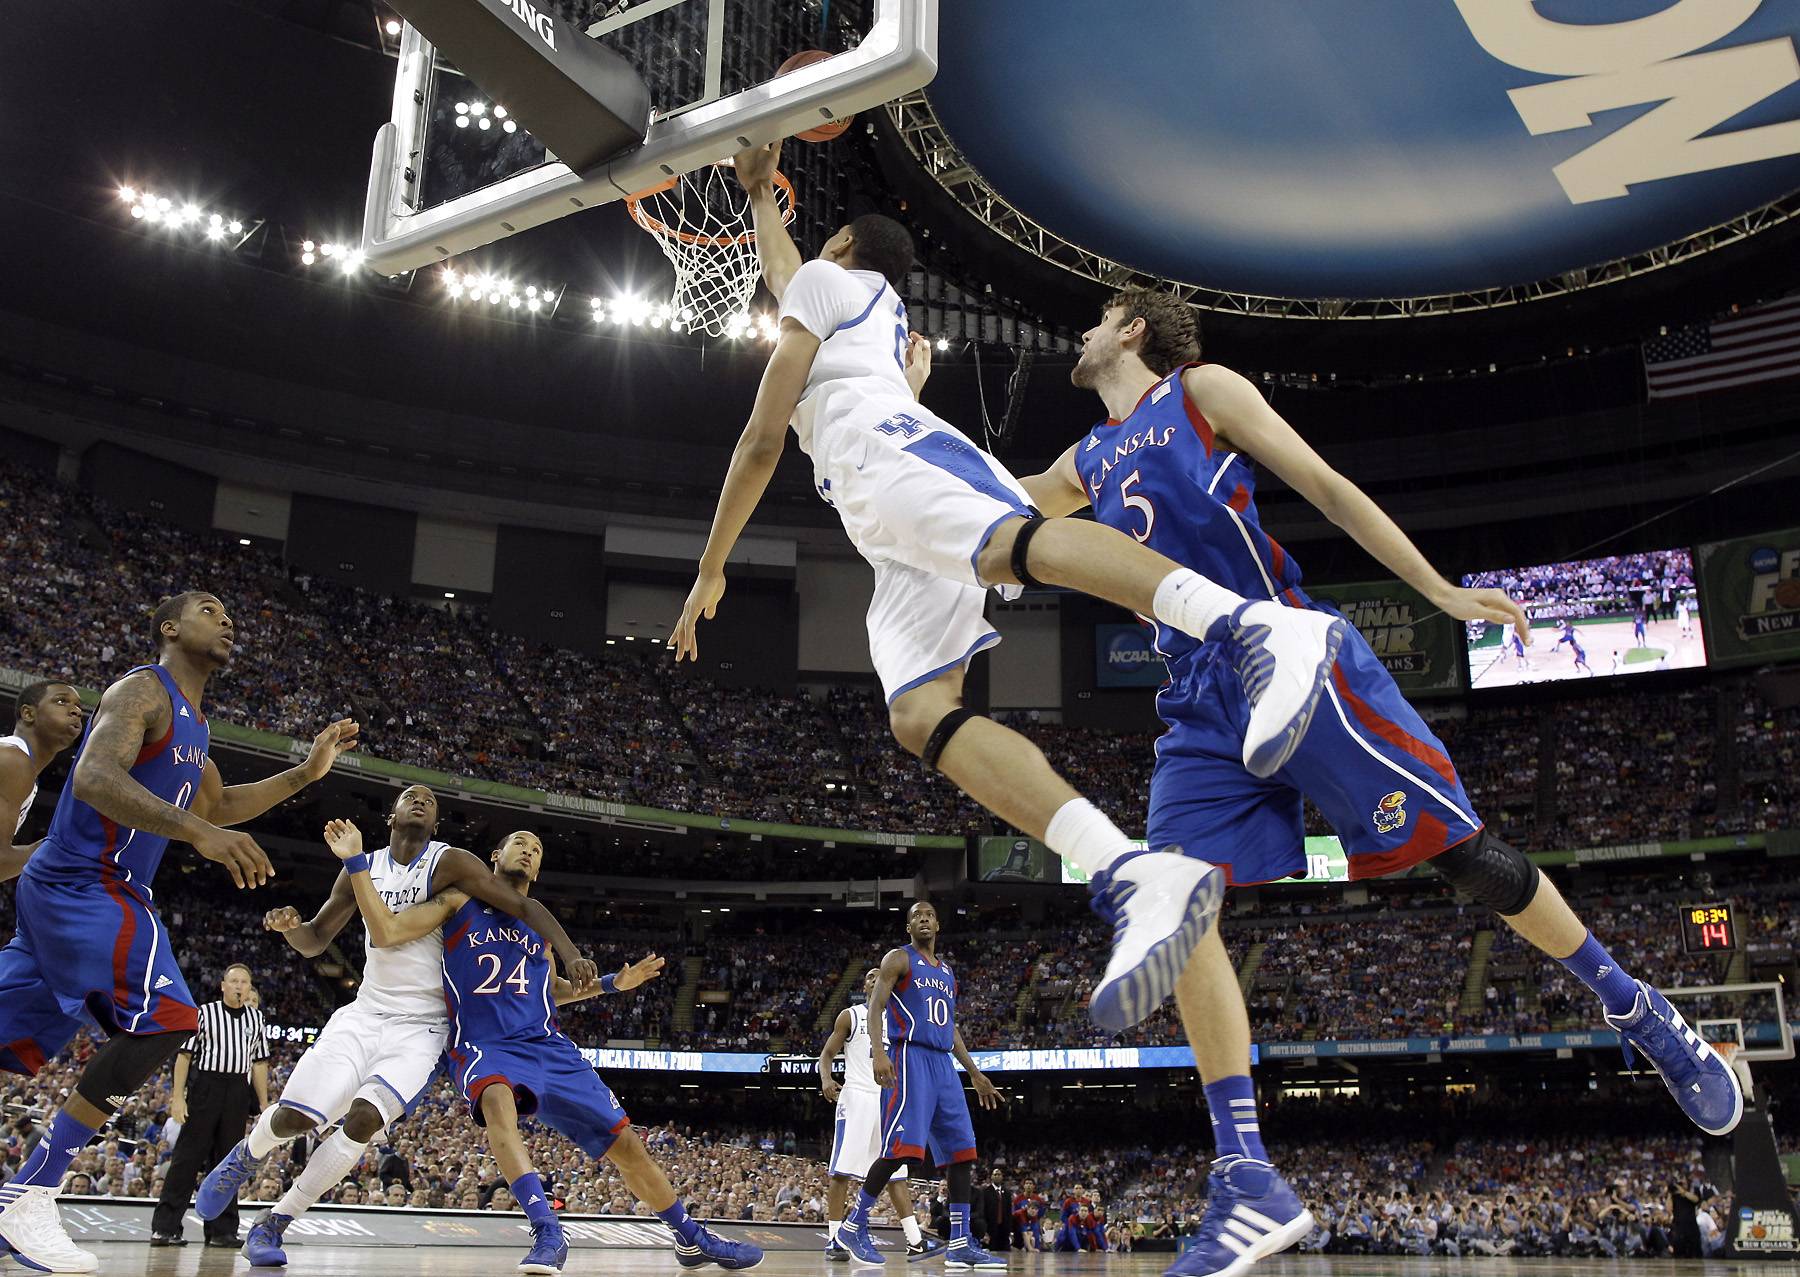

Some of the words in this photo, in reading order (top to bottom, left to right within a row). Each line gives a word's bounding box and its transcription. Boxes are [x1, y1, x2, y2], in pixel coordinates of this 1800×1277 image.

[1090, 426, 1176, 500] KANSAS
[1120, 470, 1154, 543] 5
[1340, 602, 1413, 627] FINAL
[546, 793, 564, 807] 2012
[564, 796, 584, 810] NCAA
[585, 799, 605, 814] FINAL
[606, 802, 626, 817] FOUR
[896, 834, 916, 847] HERE
[1691, 908, 1728, 924] 18:34
[467, 928, 541, 955] KANSAS
[1702, 923, 1728, 947] 14
[473, 953, 530, 995] 24
[925, 996, 948, 1026] 10
[266, 1024, 303, 1043] 18:34
[306, 1034, 315, 1044] 2
[1565, 1034, 1593, 1046] TEMPLE
[598, 1048, 631, 1069] NCAA
[632, 1050, 668, 1070] FINAL
[669, 1051, 702, 1071] FOUR
[780, 1061, 811, 1074] NEW
[1002, 1051, 1031, 1071] 2012
[1032, 1049, 1066, 1070] NCAA
[1067, 1048, 1104, 1069] FINAL
[1105, 1047, 1140, 1068] FOUR
